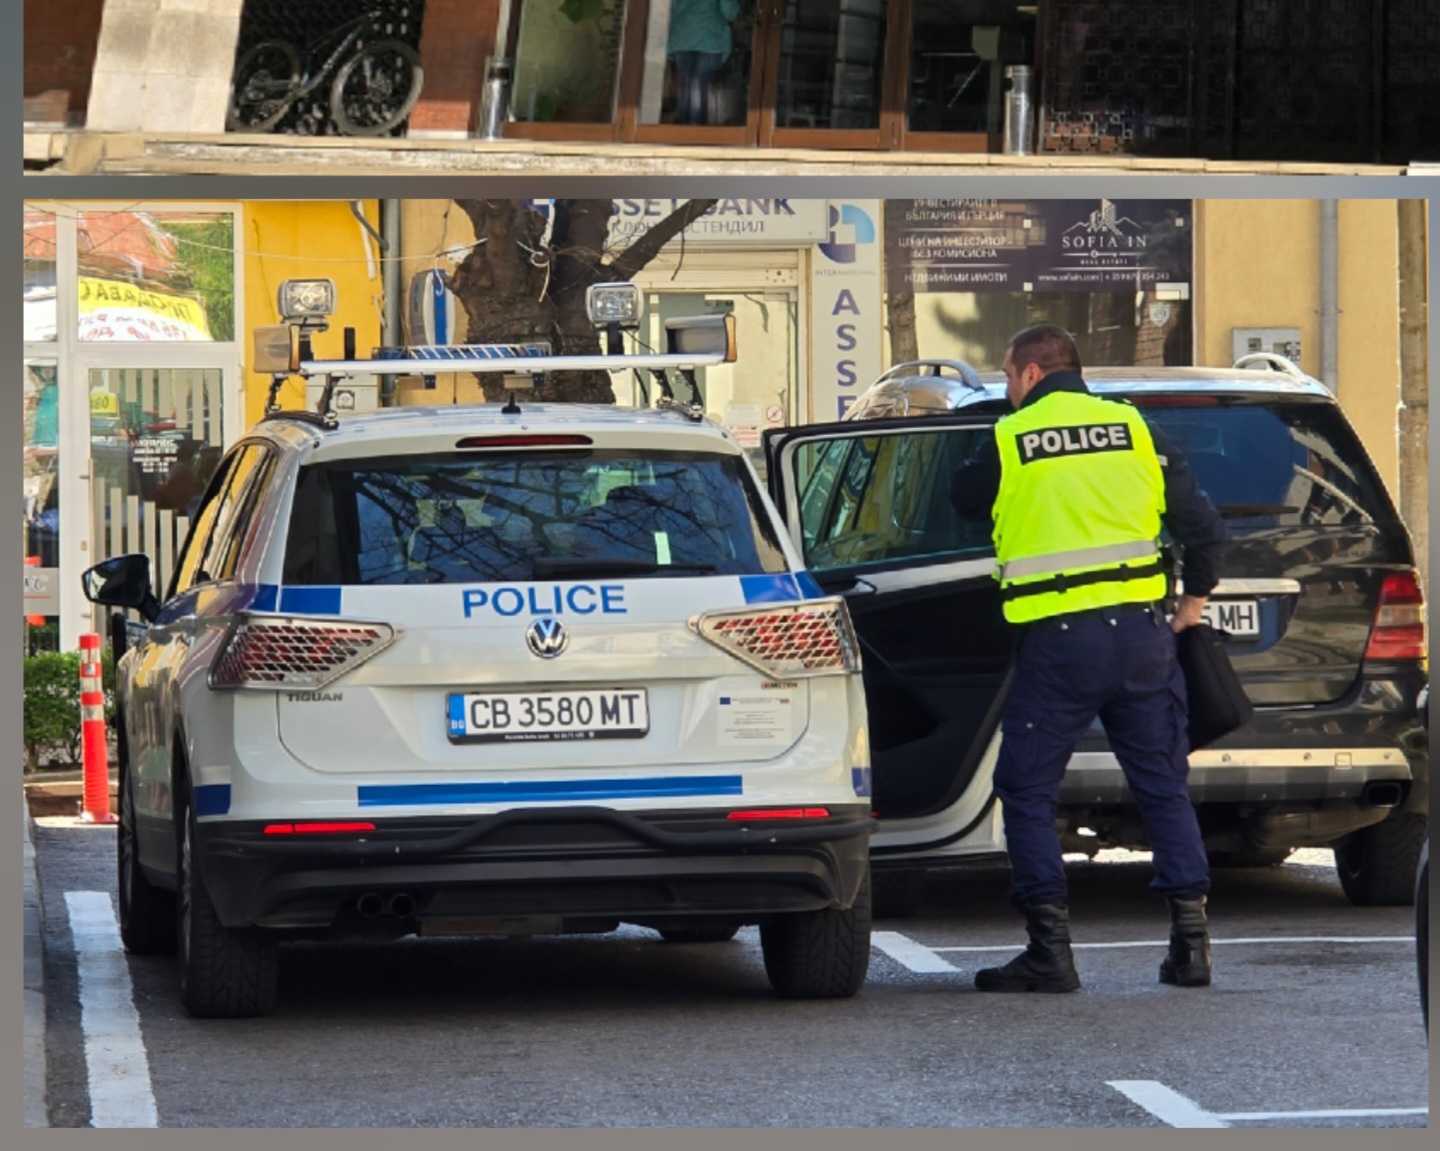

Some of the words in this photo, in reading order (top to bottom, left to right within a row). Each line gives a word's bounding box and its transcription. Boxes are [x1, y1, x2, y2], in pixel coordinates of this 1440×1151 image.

[685, 220, 765, 235] СТЕНДИЛ
[1062, 235, 1119, 248] SOFIA
[1127, 235, 1148, 248] IN
[1021, 425, 1129, 458] POLICE
[461, 584, 629, 618] POLICE
[285, 691, 344, 703] TIGUAN
[470, 699, 512, 730] CB
[518, 696, 594, 728] 3580
[599, 694, 641, 726] MT
